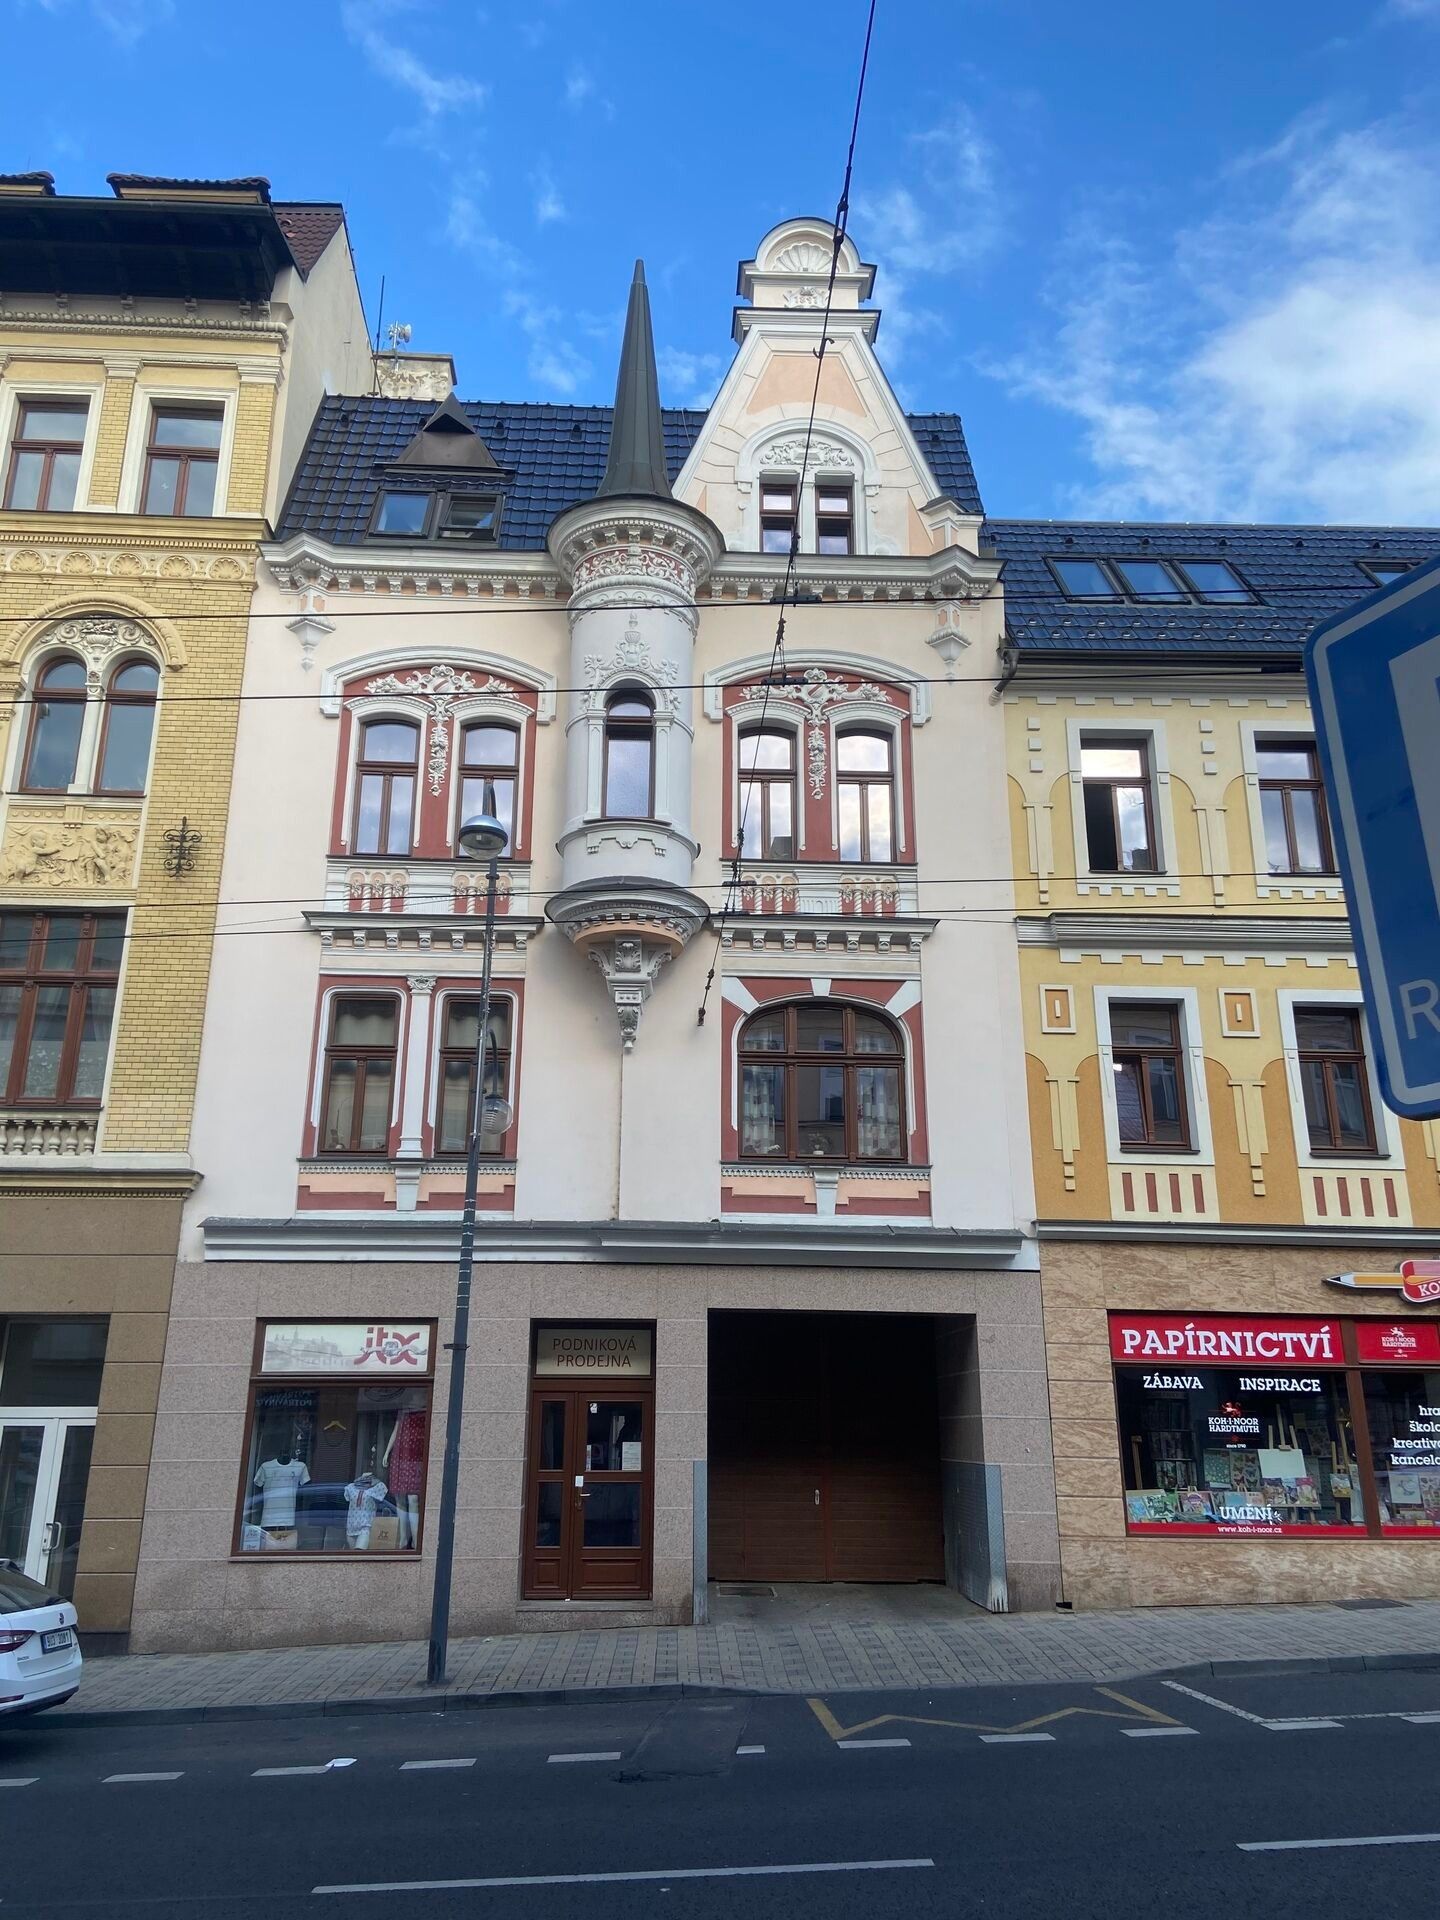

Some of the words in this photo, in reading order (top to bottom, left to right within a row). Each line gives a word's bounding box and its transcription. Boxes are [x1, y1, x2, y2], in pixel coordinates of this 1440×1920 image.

[1418, 1281, 1440, 1298] KO
[552, 1335, 637, 1352] PODNIKOVÁ
[1121, 1322, 1334, 1359] PAPÍRNICTVÍ
[557, 1354, 632, 1368] PRODEJNA
[1143, 1372, 1204, 1390] ZÁBAVA
[1239, 1377, 1322, 1392] INSPIRACE
[1208, 1425, 1260, 1433] HARDTMUTH
[1219, 1503, 1273, 1520] UMĚNÍ
[1217, 1525, 1282, 1534] www.koh-i-noor.cz
